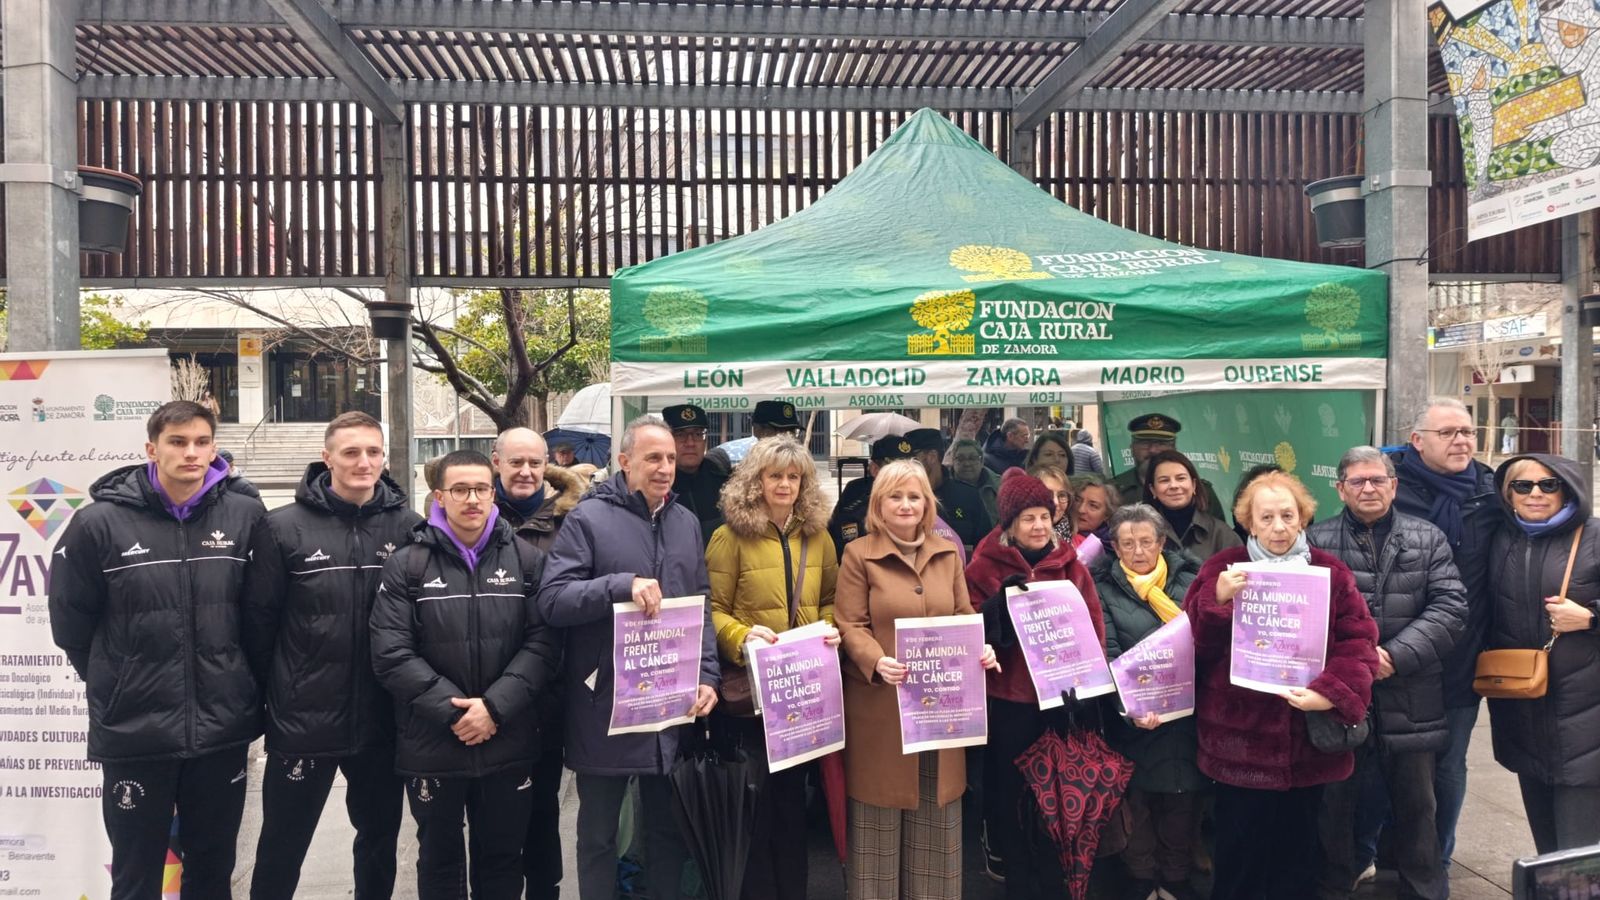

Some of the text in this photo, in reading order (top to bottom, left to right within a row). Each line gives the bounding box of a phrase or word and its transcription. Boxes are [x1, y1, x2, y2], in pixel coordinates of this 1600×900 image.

[1035, 249, 1207, 266] FUNDACION
[1050, 255, 1220, 274] CAJA RURAL
[1089, 269, 1162, 279] ZAMORA
[979, 300, 1116, 320] FUNDACION
[980, 321, 1113, 341] CAJA RURAL
[1500, 318, 1527, 335] SAF
[982, 344, 1058, 355] DE ZAMORA
[683, 364, 1323, 388] LEÓN VALLADOLID ZAMORA MADRID OURENSE
[116, 401, 162, 409] FUNDACION
[56, 412, 86, 420] ZAMORA
[25, 450, 77, 471] frente
[79, 448, 97, 461] al
[98, 451, 146, 461] cáncer
[1242, 589, 1309, 605] DÍA MUNDIAL
[1019, 610, 1032, 622] DÍA
[1033, 603, 1073, 620] MUNDIAL
[1241, 602, 1278, 614] FRENTE
[1023, 620, 1052, 634] FRENTE
[1241, 615, 1301, 629] AL CÁNCER
[624, 628, 686, 644] DÍA MUNDIAL
[1028, 626, 1075, 645] AL CÁNCER
[623, 643, 659, 657] FRENTE
[905, 645, 968, 659] DÍA MUNDIAL
[624, 653, 679, 671] AL CÁNCER
[766, 657, 824, 678] DÍA MUNDIAL
[906, 659, 941, 672] FRENTE
[768, 674, 802, 691] FRENTE
[906, 670, 963, 684] AL CÁNCER
[771, 683, 821, 704] AL CÁNCER
[35, 706, 47, 715] del
[49, 706, 70, 715] Medio
[42, 731, 88, 742] CULTURA
[28, 759, 40, 769] DE
[6, 786, 12, 797] A
[15, 786, 27, 797] LA
